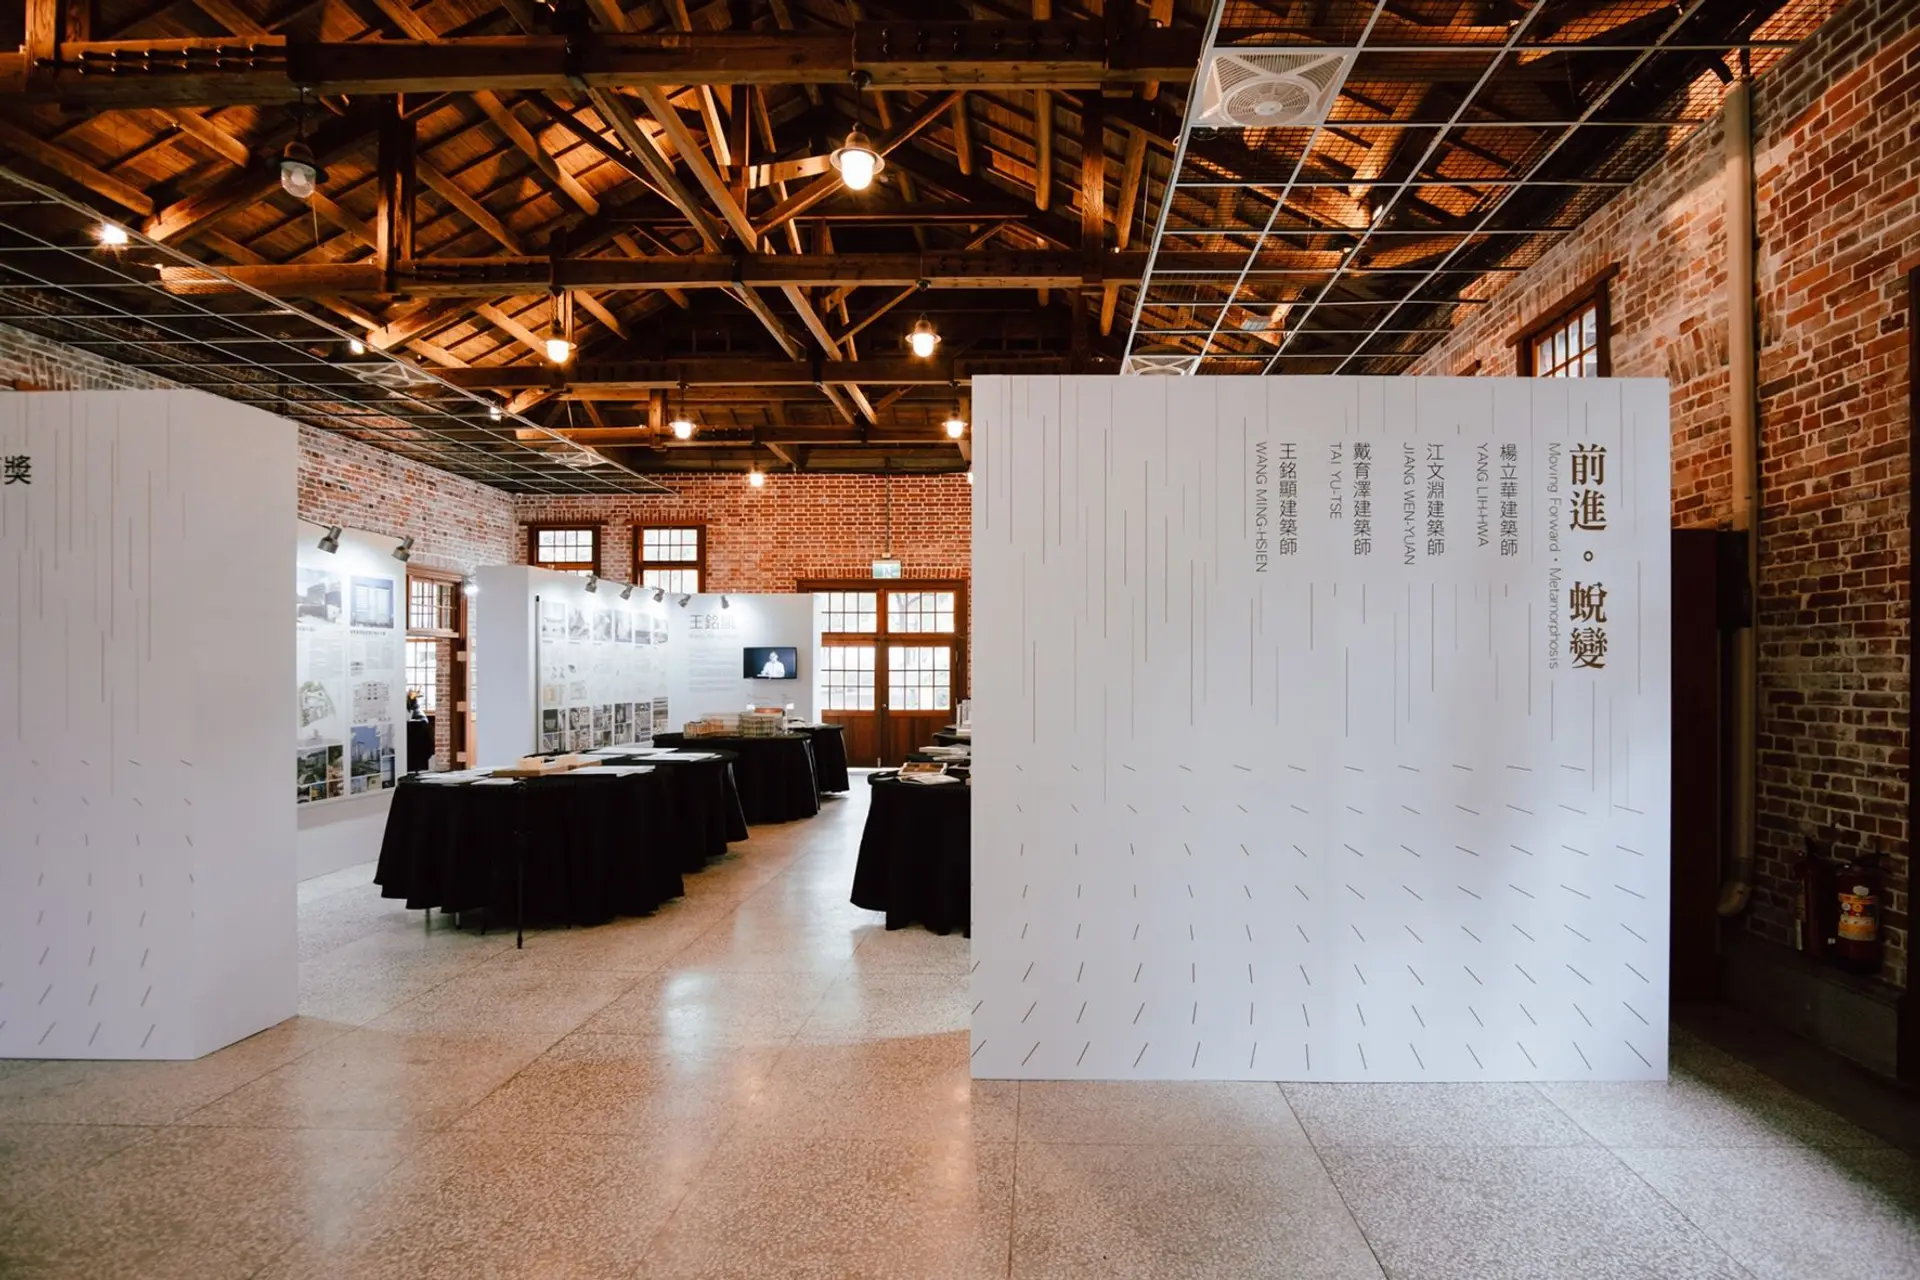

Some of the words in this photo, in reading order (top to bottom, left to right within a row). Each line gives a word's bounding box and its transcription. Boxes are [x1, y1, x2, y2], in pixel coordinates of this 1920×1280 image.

[0, 455, 31, 485] 獎
[1256, 441, 1268, 484] WANG
[1329, 442, 1342, 465] TAI
[1403, 442, 1416, 485] JIANG
[1476, 442, 1489, 482] YANG
[1547, 442, 1562, 493] Moving
[1279, 442, 1298, 556] 王銘顯建築師
[1329, 470, 1342, 519] YU-TSE
[1353, 442, 1372, 556] 戴育澤建築師
[1476, 486, 1489, 548] LIH-HWA
[1499, 442, 1518, 557] 楊立華建築師
[1256, 488, 1268, 572] MING-HSIEN
[1403, 489, 1416, 565] WEN-YUAN
[1548, 497, 1562, 552] Forward
[1548, 567, 1562, 669] Metamorphosis
